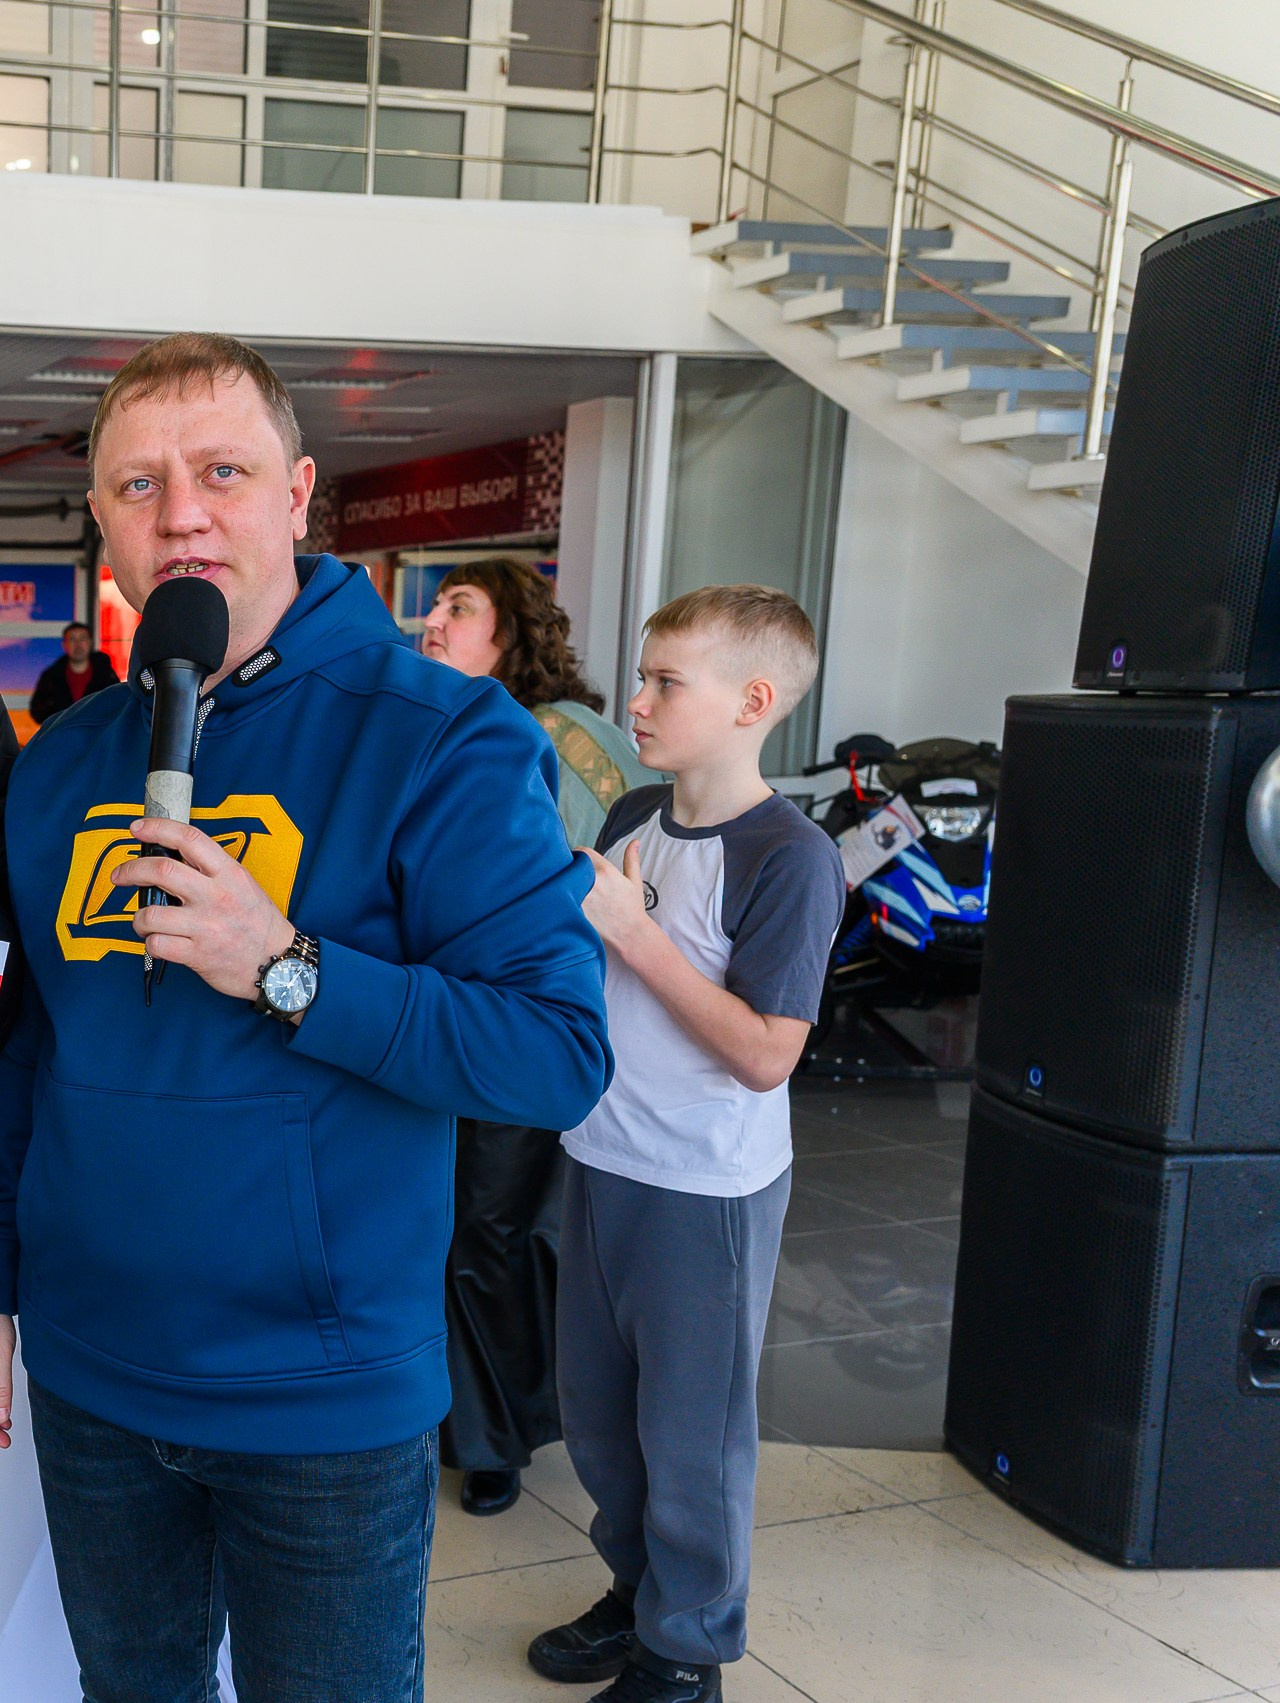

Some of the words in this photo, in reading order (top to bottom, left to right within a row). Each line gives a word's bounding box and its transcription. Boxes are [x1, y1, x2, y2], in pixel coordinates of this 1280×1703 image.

[343, 496, 402, 524] СПАСИБО
[404, 492, 421, 516] ЗА
[423, 486, 458, 513] ВАШ
[459, 476, 519, 508] ВЫБОР!
[676, 1670, 699, 1681] FILA
